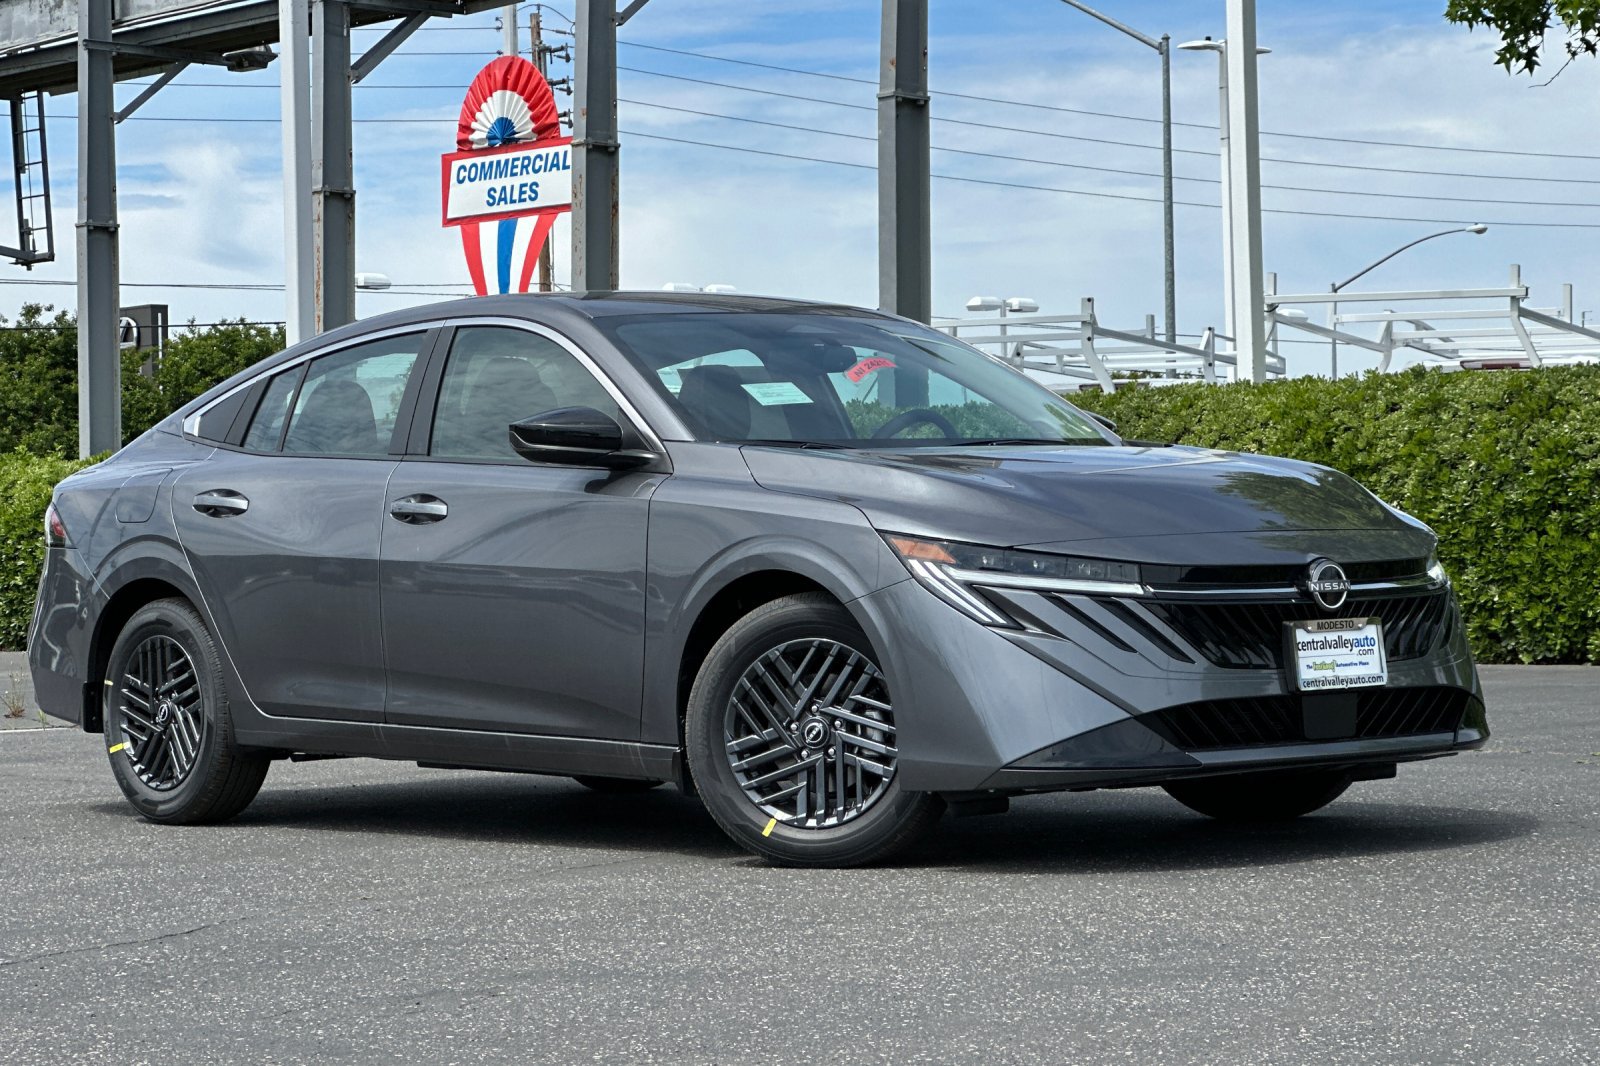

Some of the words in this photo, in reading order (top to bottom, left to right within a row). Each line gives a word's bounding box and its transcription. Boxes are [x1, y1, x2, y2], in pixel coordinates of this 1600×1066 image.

[456, 150, 571, 185] COMMERCIAL
[486, 181, 540, 207] SALES
[1310, 582, 1350, 591] NISSAN
[1316, 620, 1355, 631] MODESTO
[1297, 635, 1376, 652] centralvalleyauto
[1356, 648, 1375, 656] .com
[1302, 675, 1384, 688] centralvalleyauto.com
